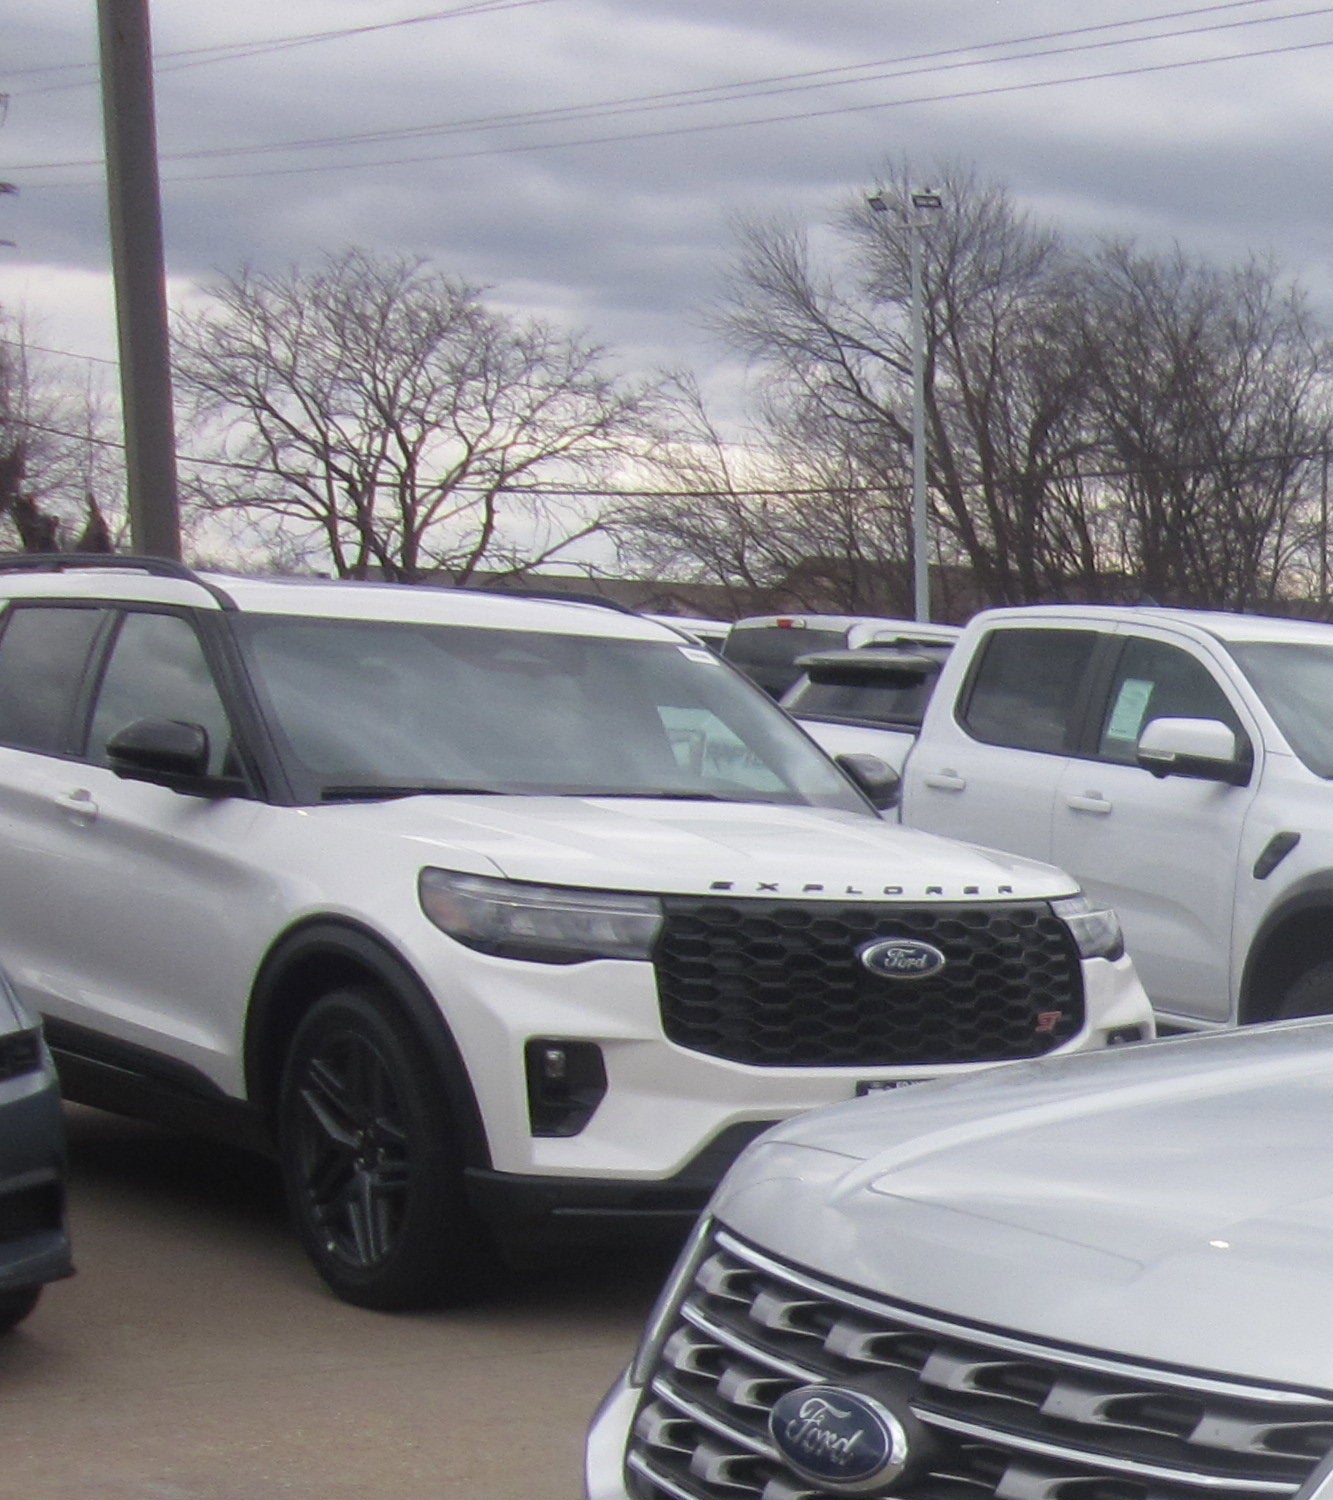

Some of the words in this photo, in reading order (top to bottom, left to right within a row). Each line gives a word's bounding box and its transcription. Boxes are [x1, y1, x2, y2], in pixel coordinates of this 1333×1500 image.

[709, 880, 1013, 895] EXPLORER
[884, 947, 928, 969] Ford
[785, 1397, 864, 1466] Ford
